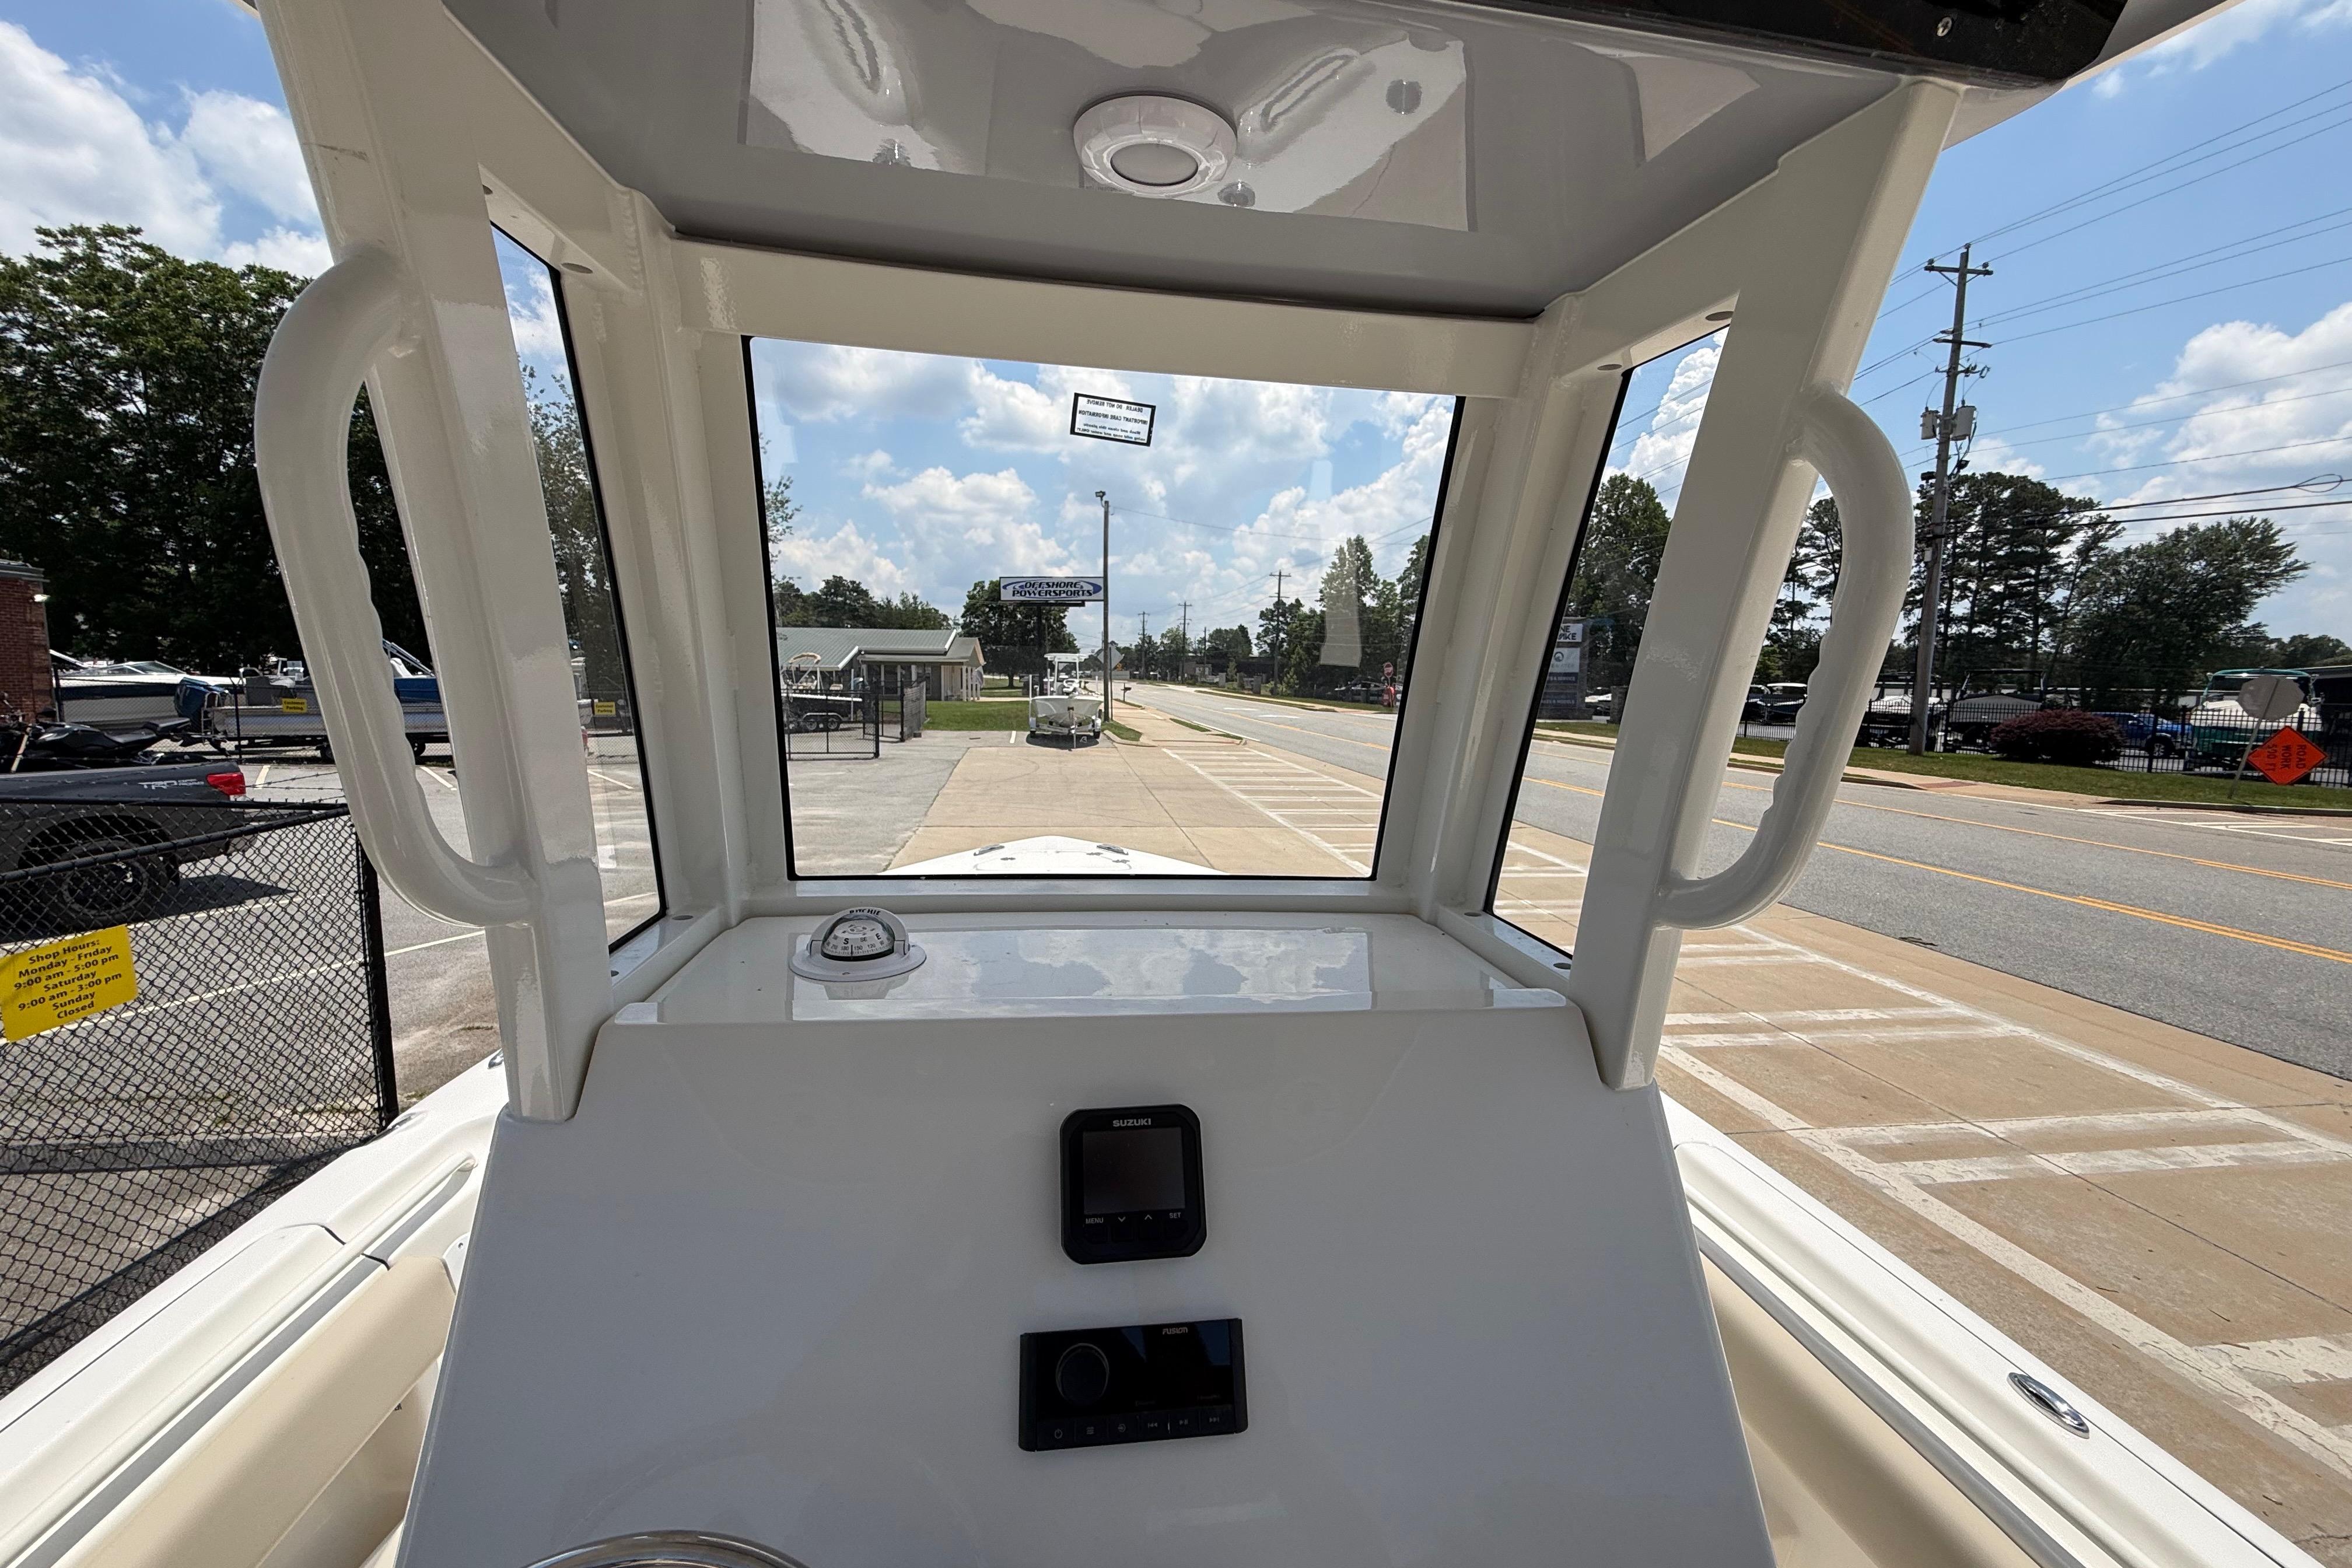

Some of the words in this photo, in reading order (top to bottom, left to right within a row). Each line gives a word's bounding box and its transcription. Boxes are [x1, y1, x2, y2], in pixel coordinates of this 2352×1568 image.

[2266, 763, 2275, 772] FT
[2280, 744, 2292, 769] WORK
[2297, 744, 2306, 769] ROAD
[849, 908, 881, 916] RITCHIE
[19, 958, 68, 978] Monday
[78, 945, 113, 960] Friday
[29, 950, 60, 964] Shop
[62, 940, 100, 954] Hours:
[14, 976, 41, 990] 9:00
[45, 971, 64, 981] am
[74, 959, 99, 972] 5:00
[101, 954, 119, 965] pm
[43, 970, 96, 992] Saturday
[18, 996, 46, 1011] 9:00
[48, 991, 68, 1002] am
[78, 978, 102, 992] 3:00
[104, 972, 122, 984] pm
[52, 991, 96, 1010] Sunday
[57, 1000, 94, 1019] Closed
[1112, 1118, 1152, 1127] SUZUKI
[1162, 1326, 1188, 1335] FUSION
